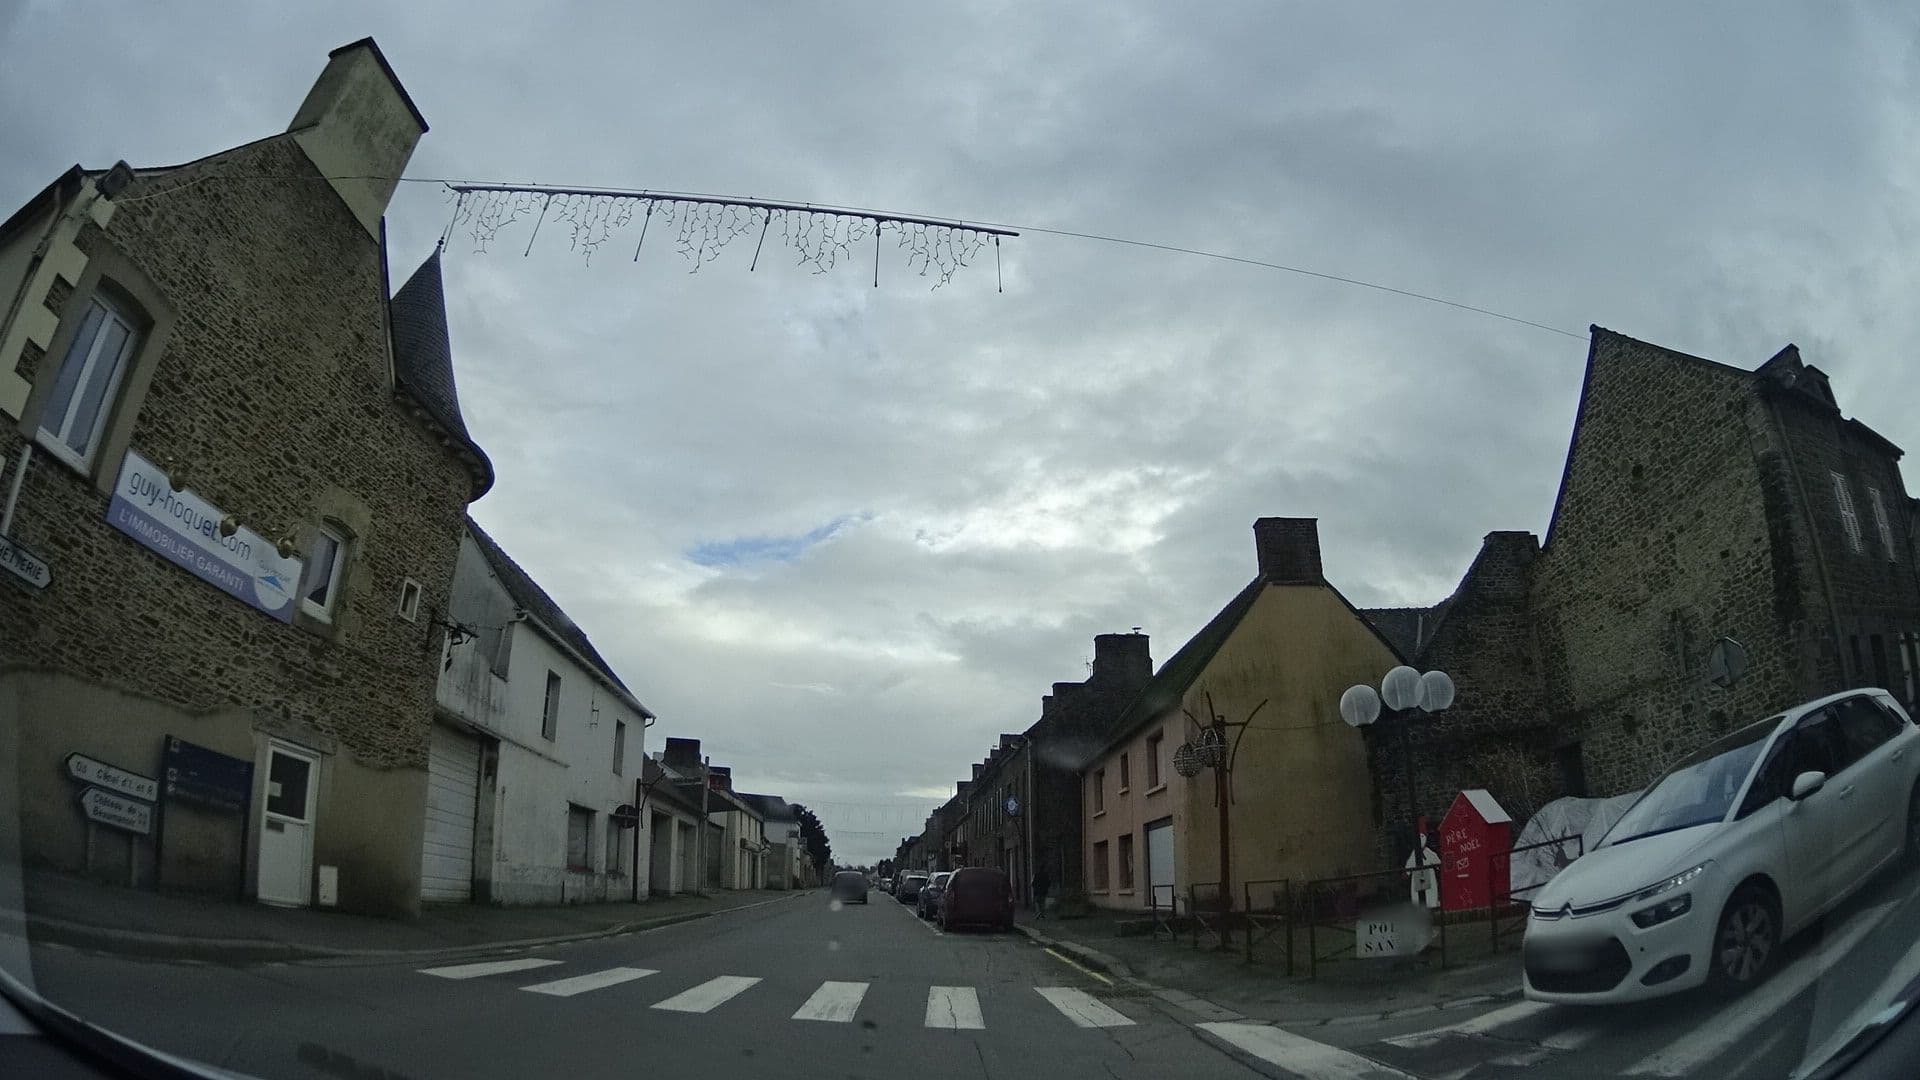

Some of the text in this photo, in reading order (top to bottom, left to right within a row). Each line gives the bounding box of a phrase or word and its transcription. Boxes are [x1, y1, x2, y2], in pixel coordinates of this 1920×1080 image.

[118, 507, 196, 565] L'IMMOBILIER
[196, 556, 244, 592] GARANTI
[129, 472, 252, 560] guy-hoquet.com
